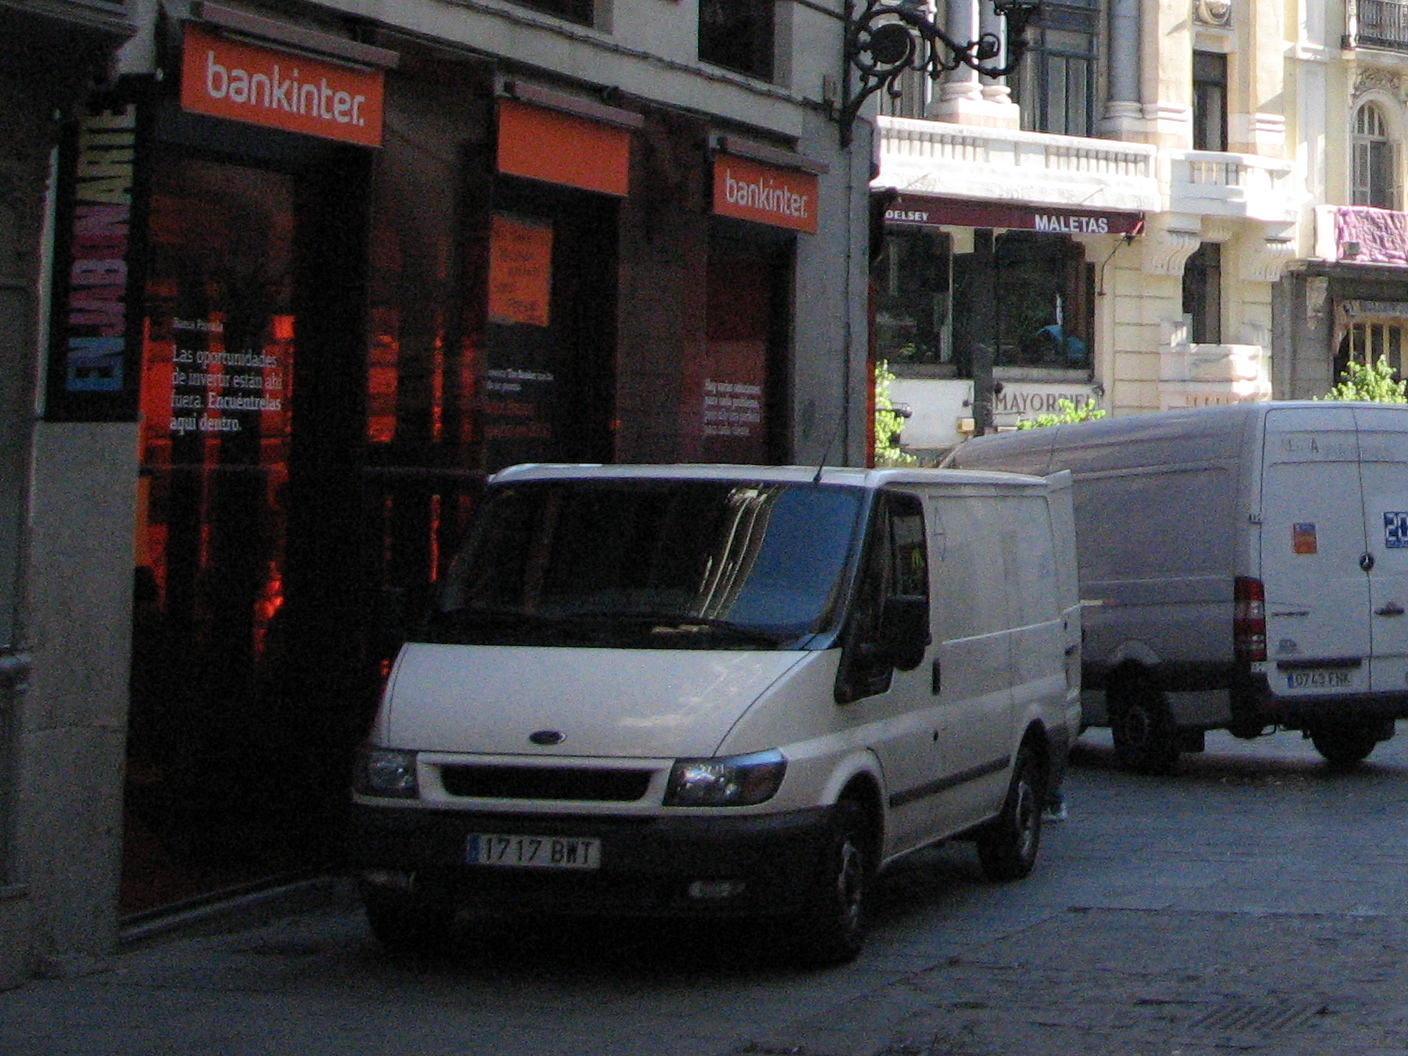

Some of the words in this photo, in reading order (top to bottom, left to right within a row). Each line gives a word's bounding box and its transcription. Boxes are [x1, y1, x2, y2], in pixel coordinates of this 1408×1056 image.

[884, 209, 930, 221] DELSEY
[1034, 214, 1109, 233] MALETAS
[172, 344, 193, 363] Las
[196, 347, 278, 370] oportunidades
[172, 365, 186, 385] de
[485, 837, 542, 862] 1717
[550, 839, 595, 865] BWT
